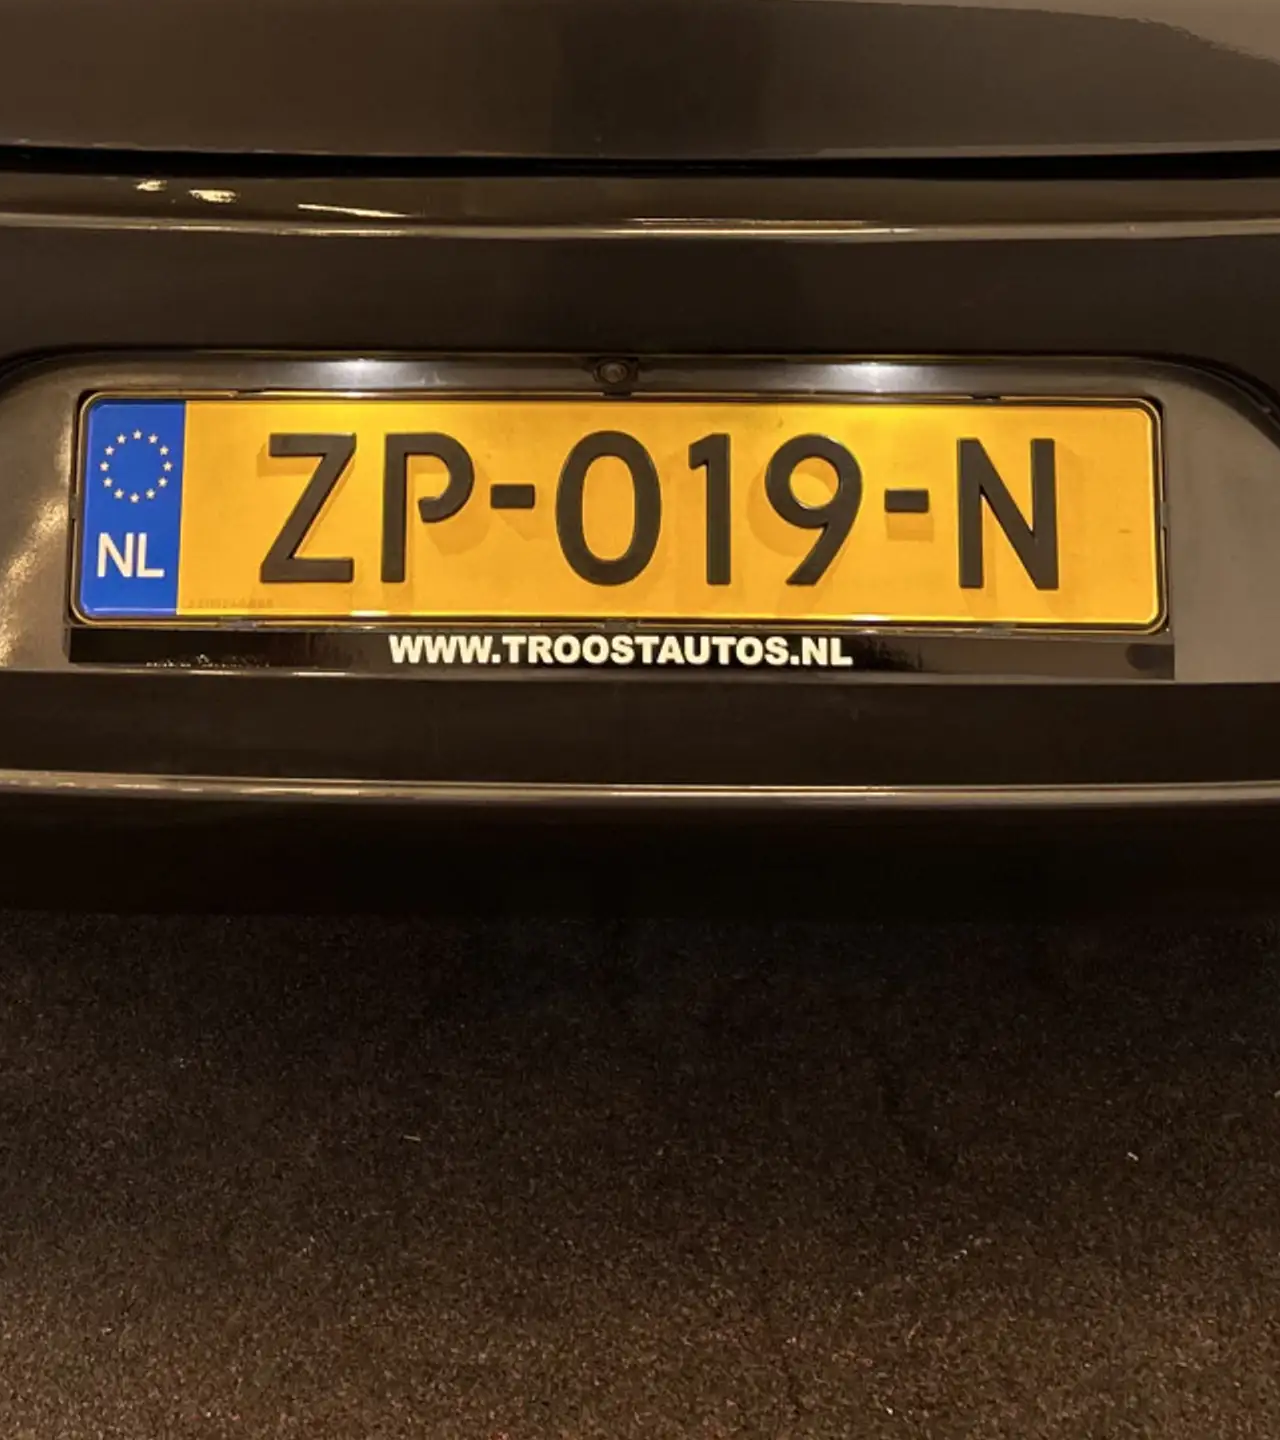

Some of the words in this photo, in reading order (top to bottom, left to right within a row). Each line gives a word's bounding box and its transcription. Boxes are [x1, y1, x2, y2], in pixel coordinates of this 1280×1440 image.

[260, 430, 1059, 591] ZP-019-N
[96, 531, 165, 578] NL
[389, 634, 853, 666] WWW.TROOSTAUTOS.NL
